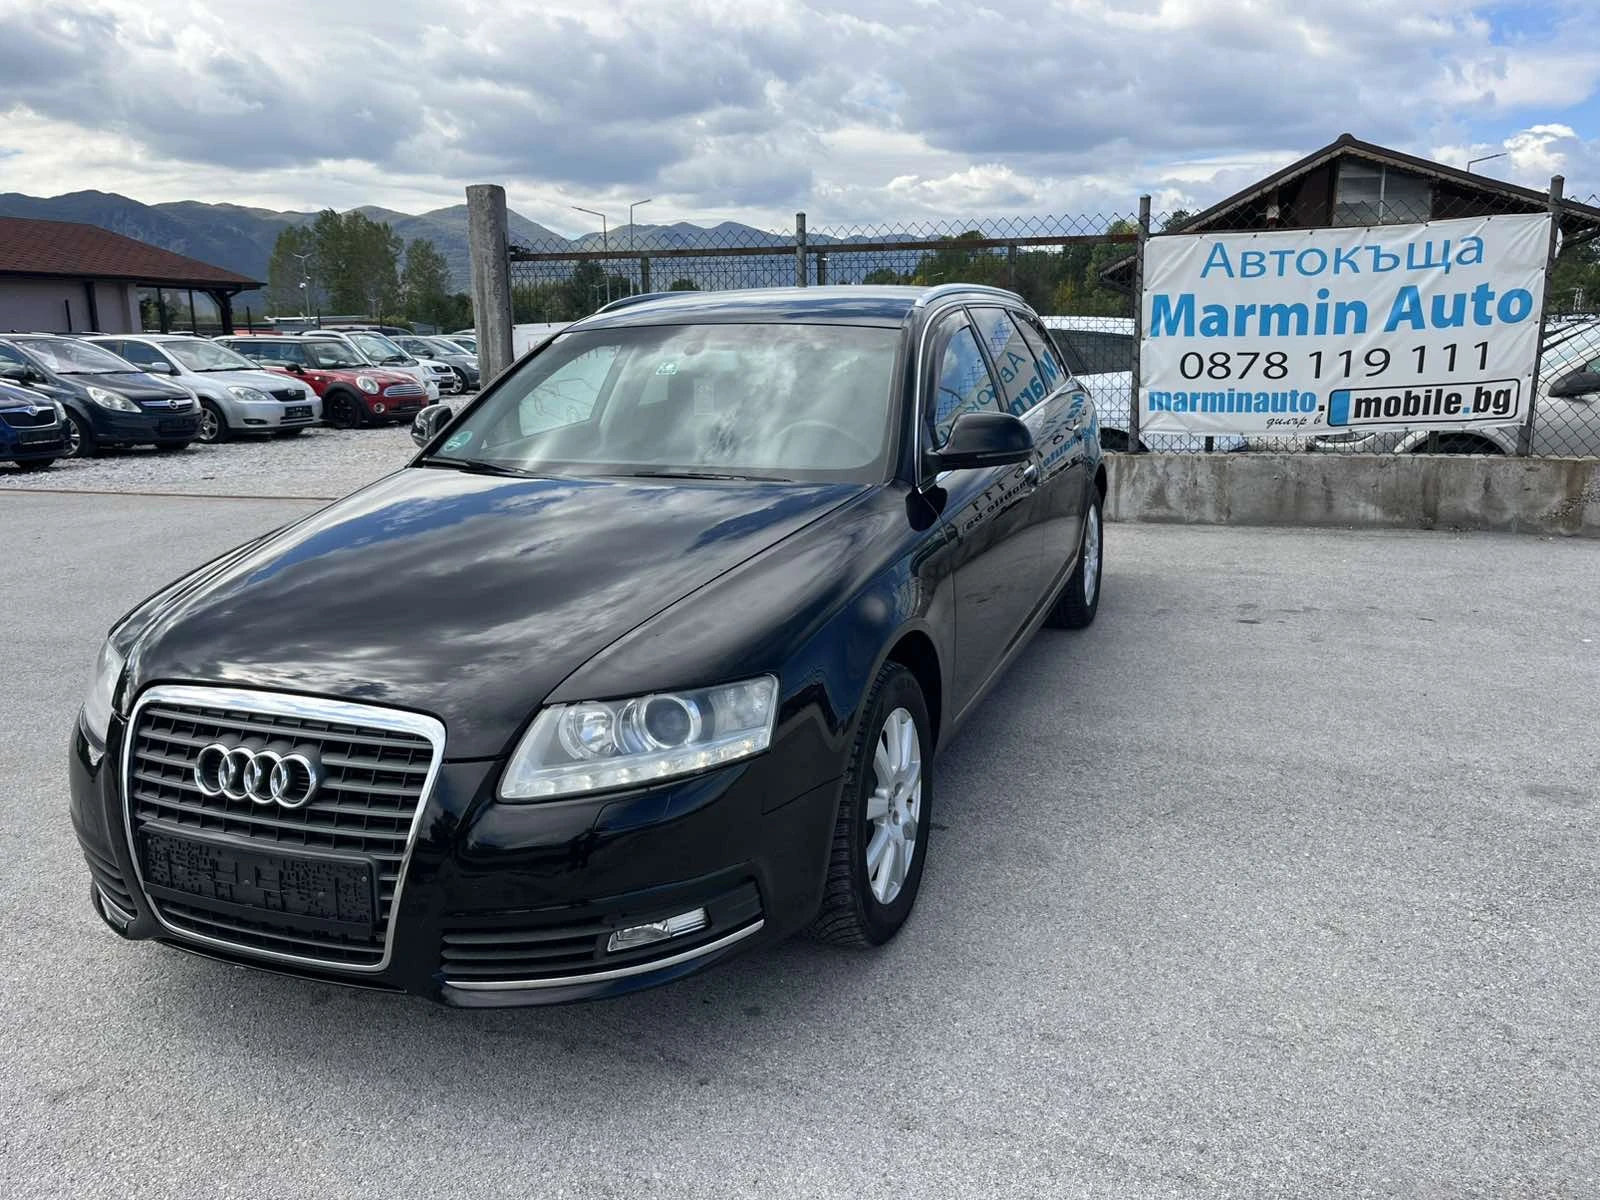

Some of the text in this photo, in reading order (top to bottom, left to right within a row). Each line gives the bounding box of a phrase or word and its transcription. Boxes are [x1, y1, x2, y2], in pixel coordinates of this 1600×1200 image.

[1200, 235, 1484, 278] Автокъща
[1150, 282, 1533, 338] Marmin Auto
[1180, 341, 1489, 380] 0878 119 111
[1353, 386, 1512, 419] mobile.bg
